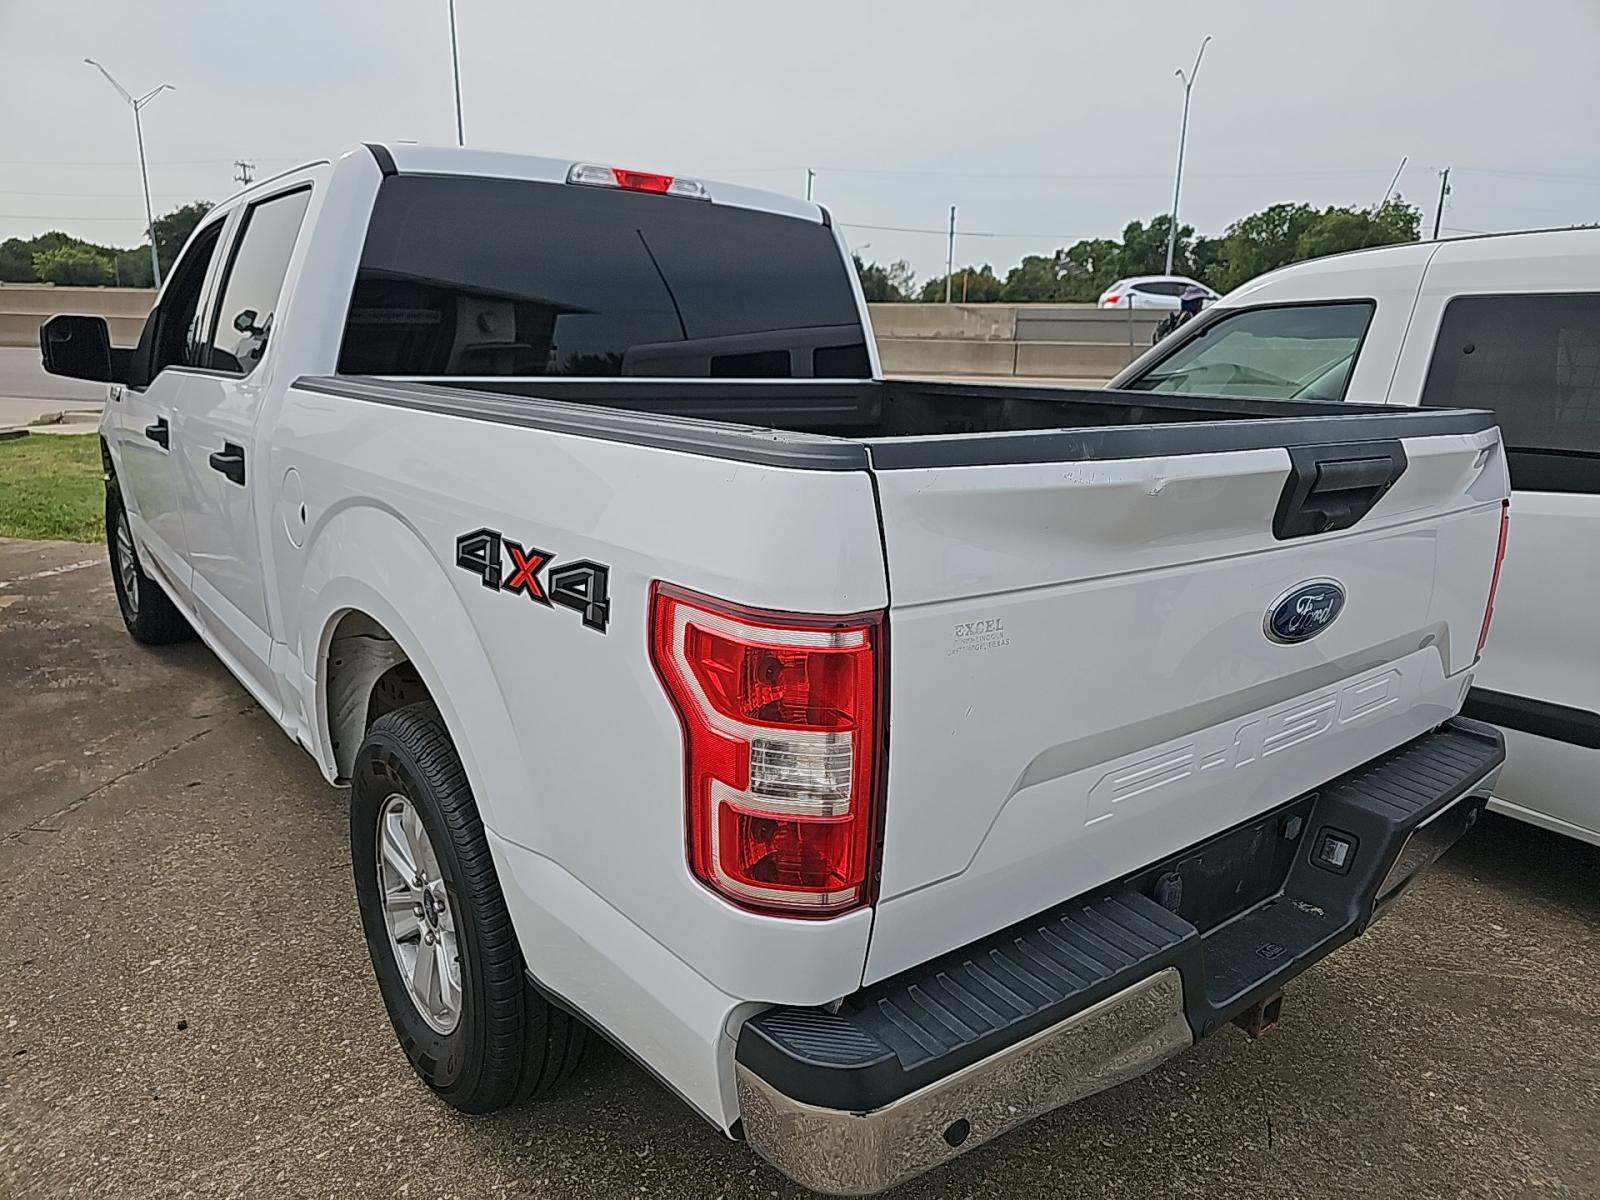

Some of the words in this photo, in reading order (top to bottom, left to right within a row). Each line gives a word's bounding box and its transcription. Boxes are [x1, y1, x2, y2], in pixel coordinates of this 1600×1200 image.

[1289, 593, 1334, 632] Ford
[953, 618, 1004, 637] EXCEL
[988, 638, 1010, 649] TEXAS
[1085, 668, 1403, 826] F-150
